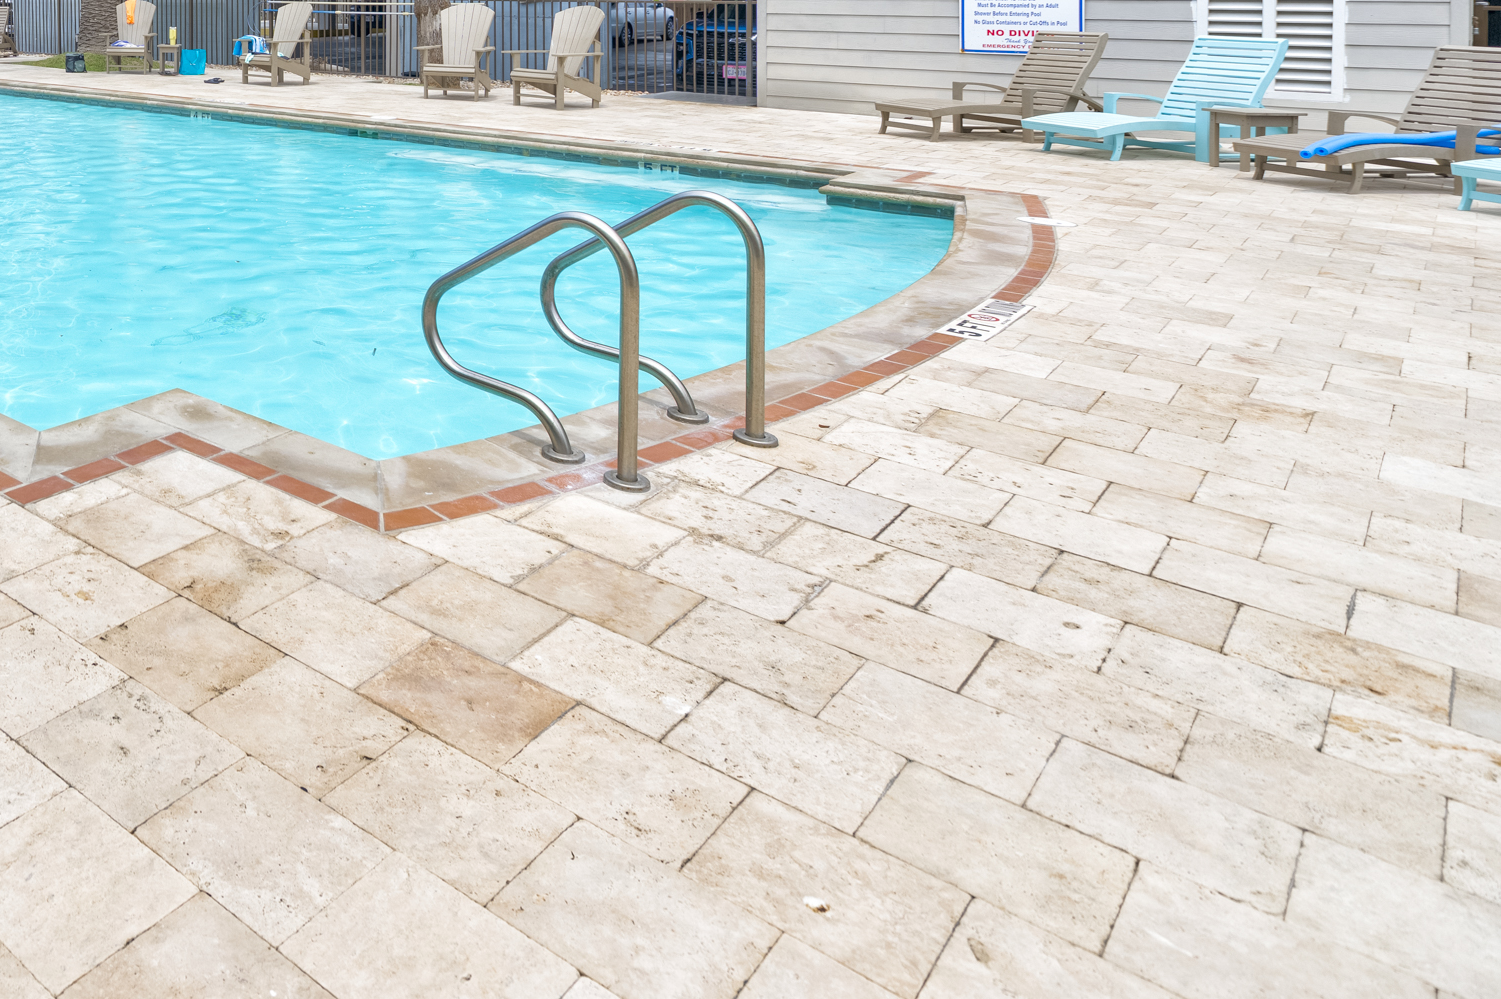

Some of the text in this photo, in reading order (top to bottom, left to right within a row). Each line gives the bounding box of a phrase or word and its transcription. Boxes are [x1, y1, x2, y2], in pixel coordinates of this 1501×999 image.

[997, 2, 1030, 10] Accompanied
[1009, 10, 1030, 18] Entering
[986, 29, 1005, 37] NO
[643, 162, 677, 173] 5 FT
[956, 319, 996, 333] FT
